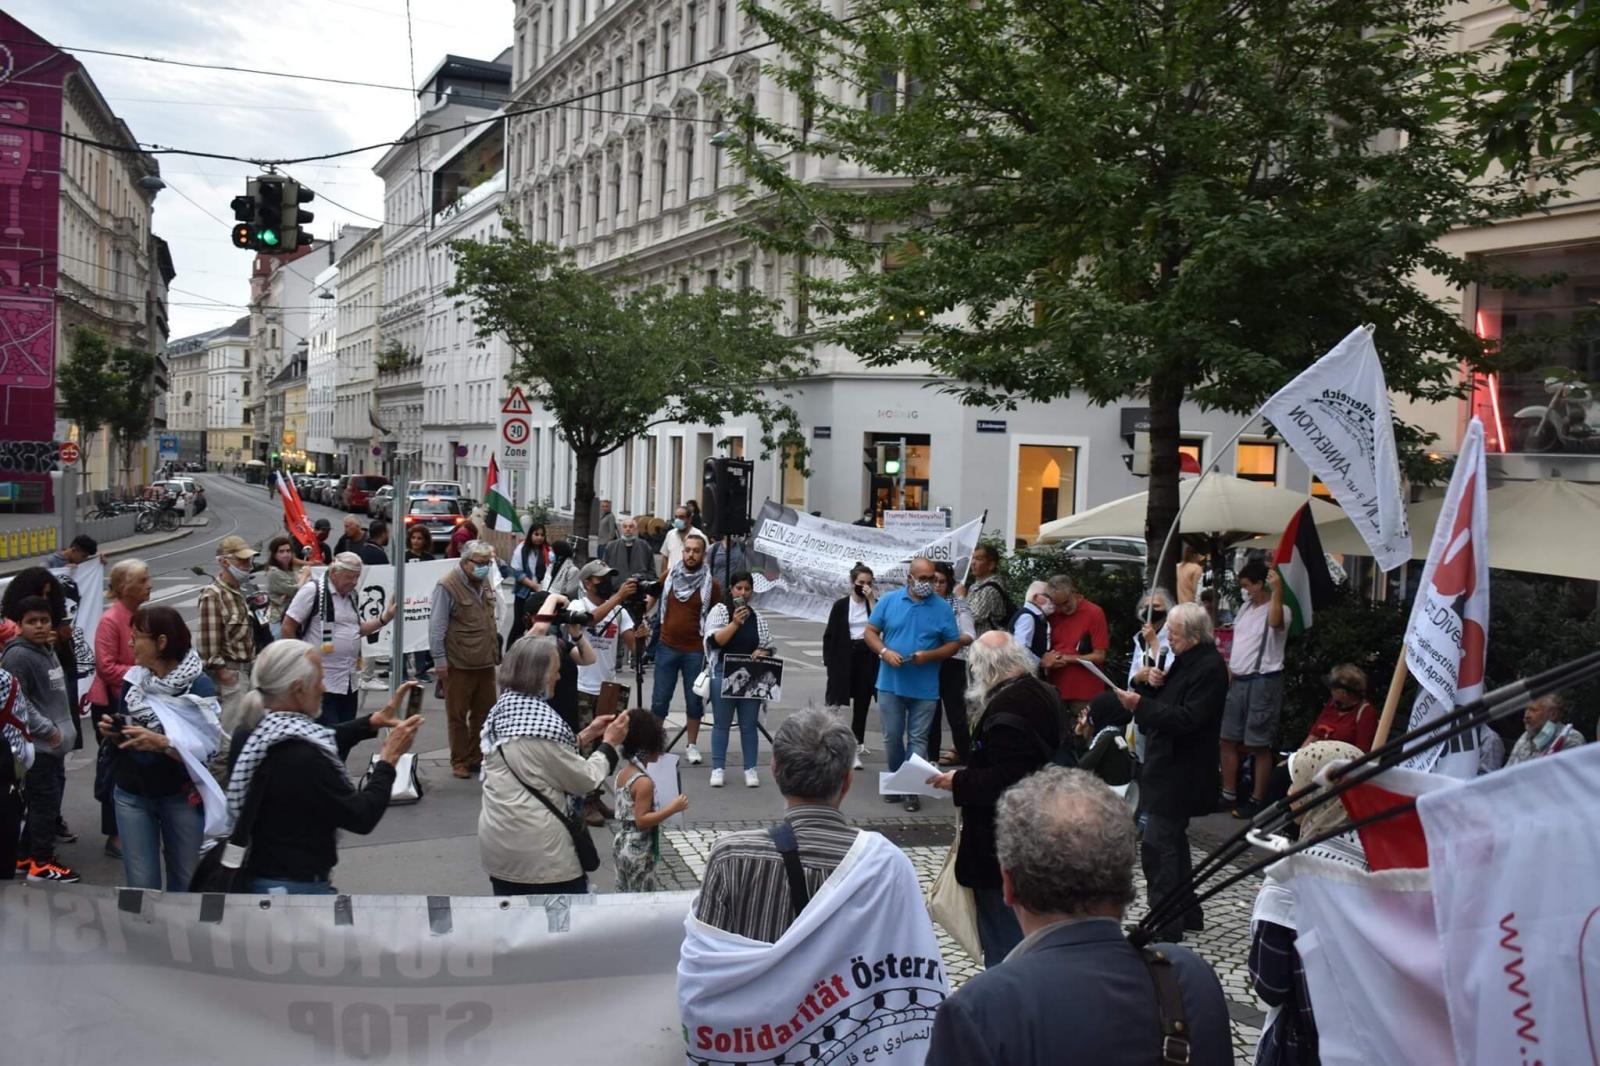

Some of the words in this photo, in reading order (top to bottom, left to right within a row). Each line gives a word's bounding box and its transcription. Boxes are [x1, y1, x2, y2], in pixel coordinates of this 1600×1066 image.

[510, 424, 523, 438] 30
[504, 445, 528, 457] Zone
[760, 520, 788, 542] NEIN
[785, 530, 804, 545] zur
[803, 533, 843, 555] Annexion
[696, 972, 851, 1054] Solidarität
[850, 952, 945, 990] Österr
[1499, 911, 1543, 1066] www.
[862, 1044, 880, 1063] مع
[883, 1026, 930, 1055] لنمساوي
